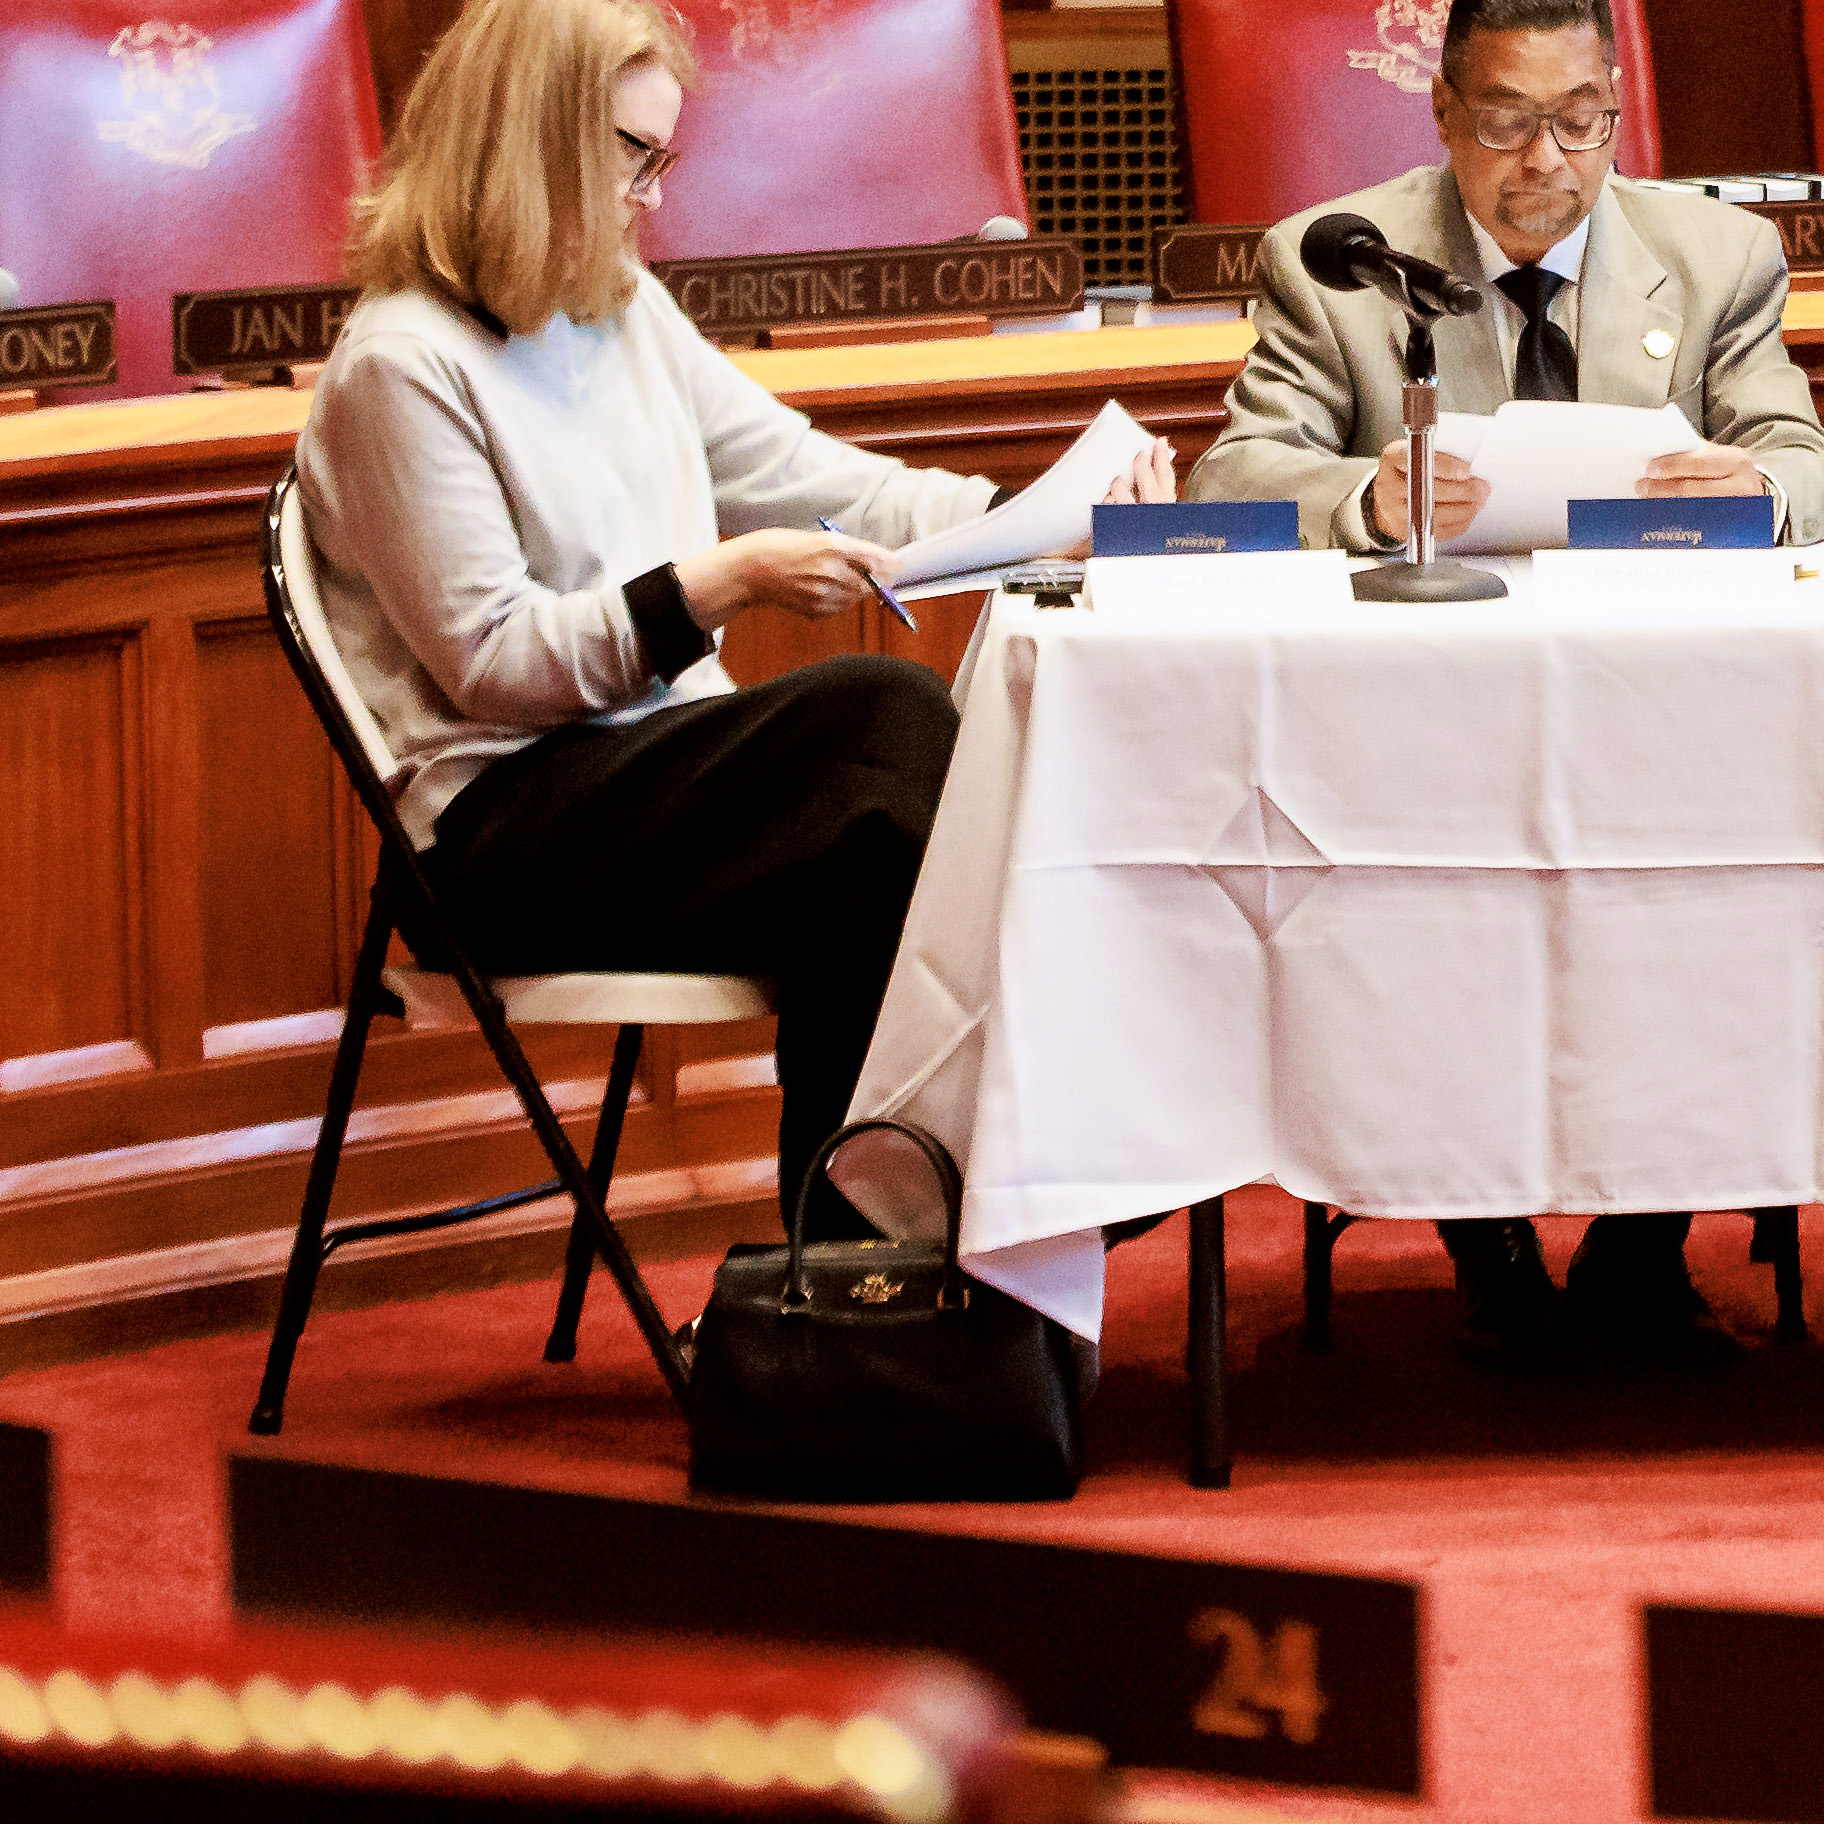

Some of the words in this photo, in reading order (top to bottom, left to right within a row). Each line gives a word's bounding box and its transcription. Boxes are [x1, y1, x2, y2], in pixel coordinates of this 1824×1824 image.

[681, 265, 865, 321] CHRISTINE
[879, 263, 920, 309] H.
[933, 254, 1063, 305] COHEN
[229, 301, 304, 354] JAN
[1190, 1607, 1328, 1745] 24
